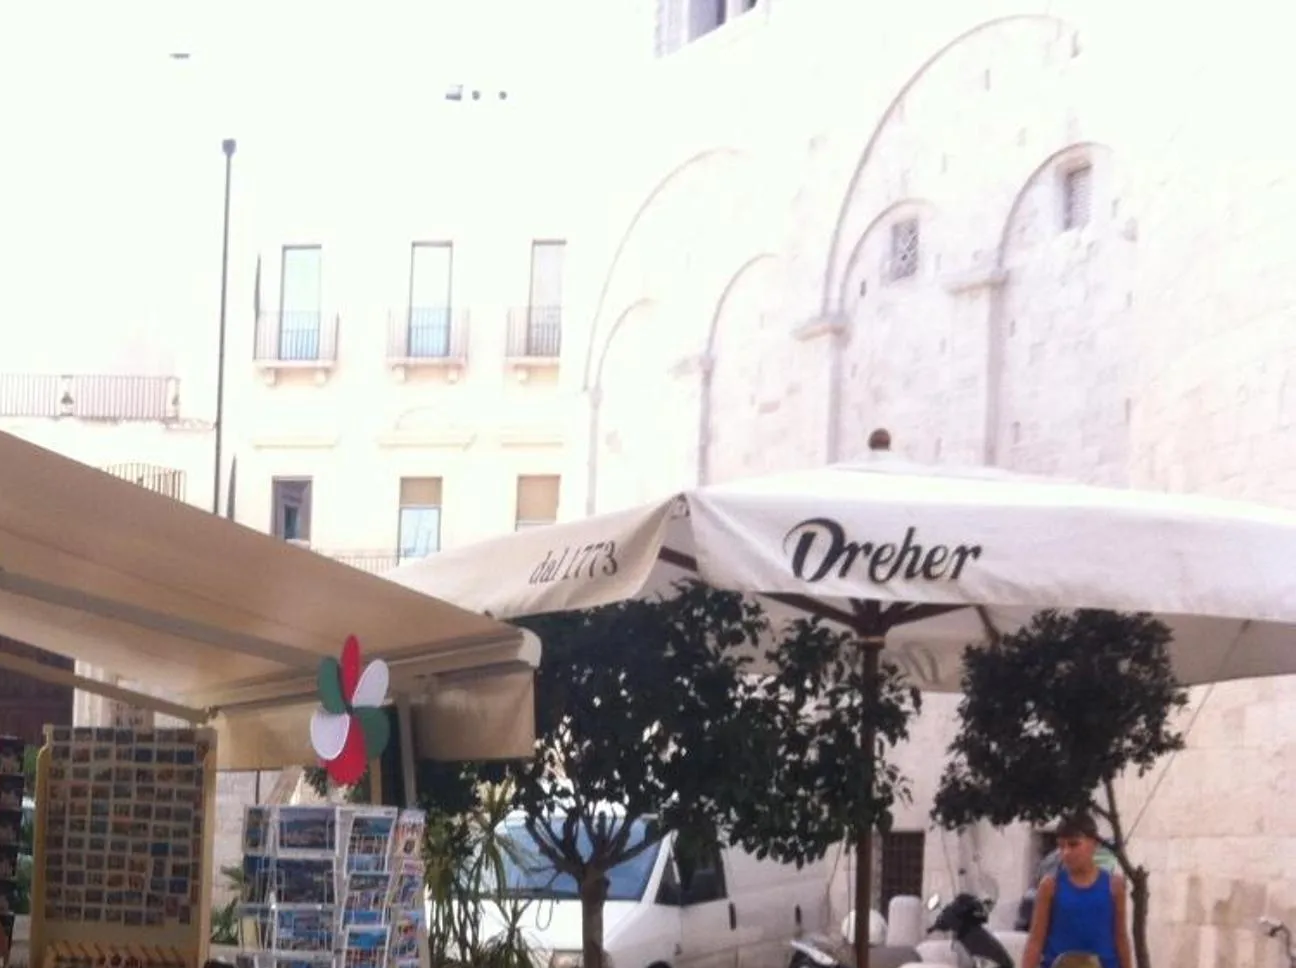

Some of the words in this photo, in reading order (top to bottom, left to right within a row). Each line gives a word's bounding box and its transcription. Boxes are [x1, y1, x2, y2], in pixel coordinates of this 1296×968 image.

[528, 546, 570, 584] dal
[562, 541, 618, 580] 1773
[782, 517, 982, 584] Dreher
